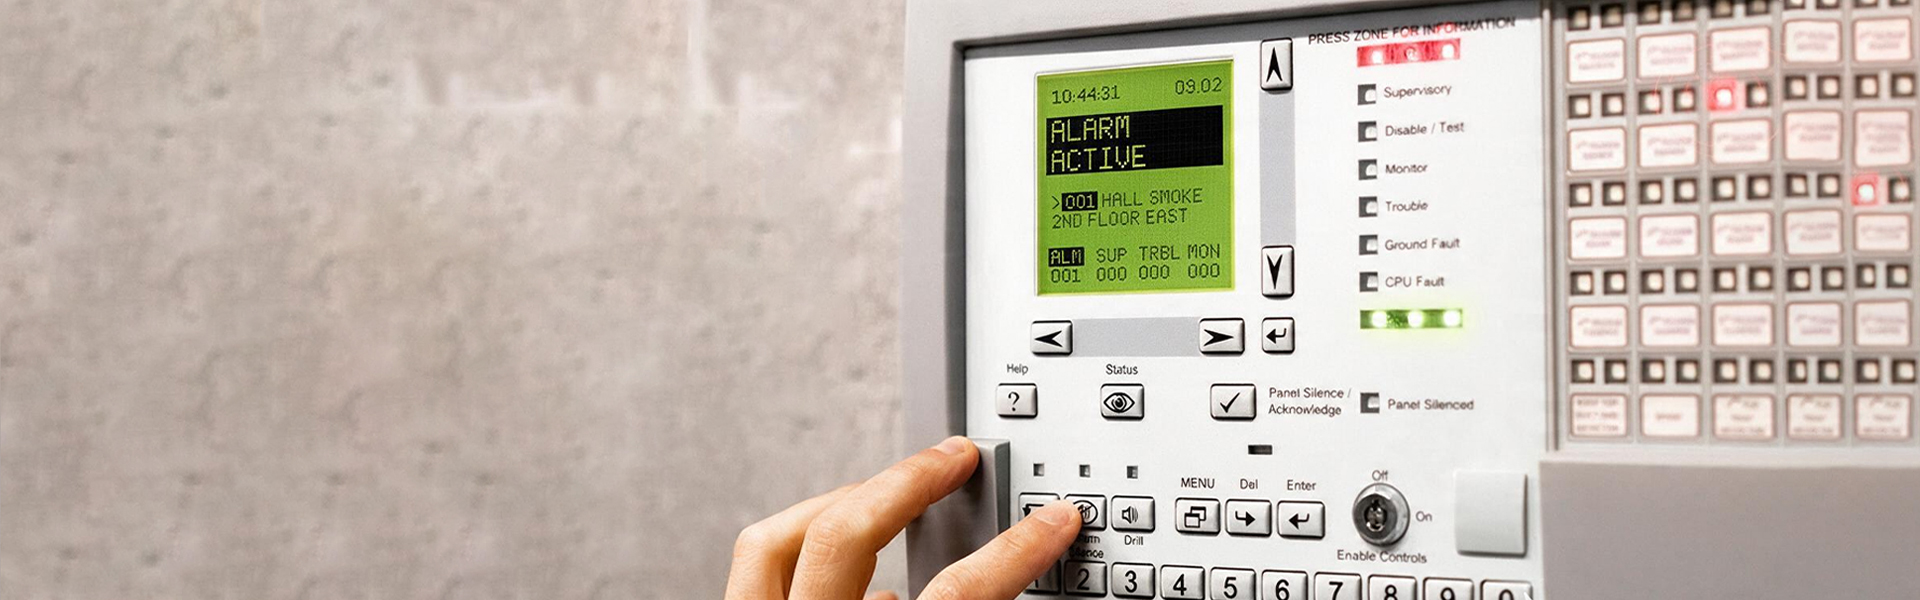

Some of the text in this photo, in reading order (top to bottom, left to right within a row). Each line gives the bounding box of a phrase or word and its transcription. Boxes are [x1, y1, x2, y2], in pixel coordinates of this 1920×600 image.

[1308, 31, 1350, 45] PRESS
[1354, 27, 1389, 42] ZONE
[1392, 25, 1419, 39] FOR
[1052, 84, 1121, 105] 10:44:31
[1384, 84, 1452, 99] Supervisory
[1051, 114, 1130, 143] ALARM
[1385, 123, 1427, 137] Disable
[1440, 121, 1465, 134] Test
[1051, 144, 1146, 173] ACTIVE
[1385, 163, 1428, 175] Monitor
[1101, 191, 1143, 208] HALL
[1149, 188, 1203, 205] SMOKE
[1385, 200, 1429, 212] Trouble
[1052, 208, 1188, 229] 2ND FLOOR EAST
[1385, 237, 1461, 251] Ground Fault
[1050, 243, 1221, 266] ALM SUP TRBL MON
[1050, 263, 1220, 283] 001 000 000 000
[1385, 274, 1445, 288] CPU Fault
[1006, 363, 1029, 376] Help
[1105, 363, 1139, 376] Status
[1269, 387, 1300, 399] Panel
[1303, 386, 1345, 399] Silence
[1268, 403, 1342, 417] Acknowledge
[1387, 398, 1475, 411] Panel Silenced
[1181, 477, 1215, 489] MENU
[1372, 470, 1389, 482] Off
[1287, 479, 1316, 491] Enter
[1416, 511, 1433, 522] On
[1124, 535, 1144, 546] Drill
[1337, 549, 1428, 564] Enable Controls
[1077, 568, 1090, 591] 2
[1124, 570, 1138, 593] 3
[1173, 573, 1188, 597] 4
[1224, 576, 1238, 599] 5
[1275, 579, 1290, 600] 6
[1329, 581, 1344, 600] 7
